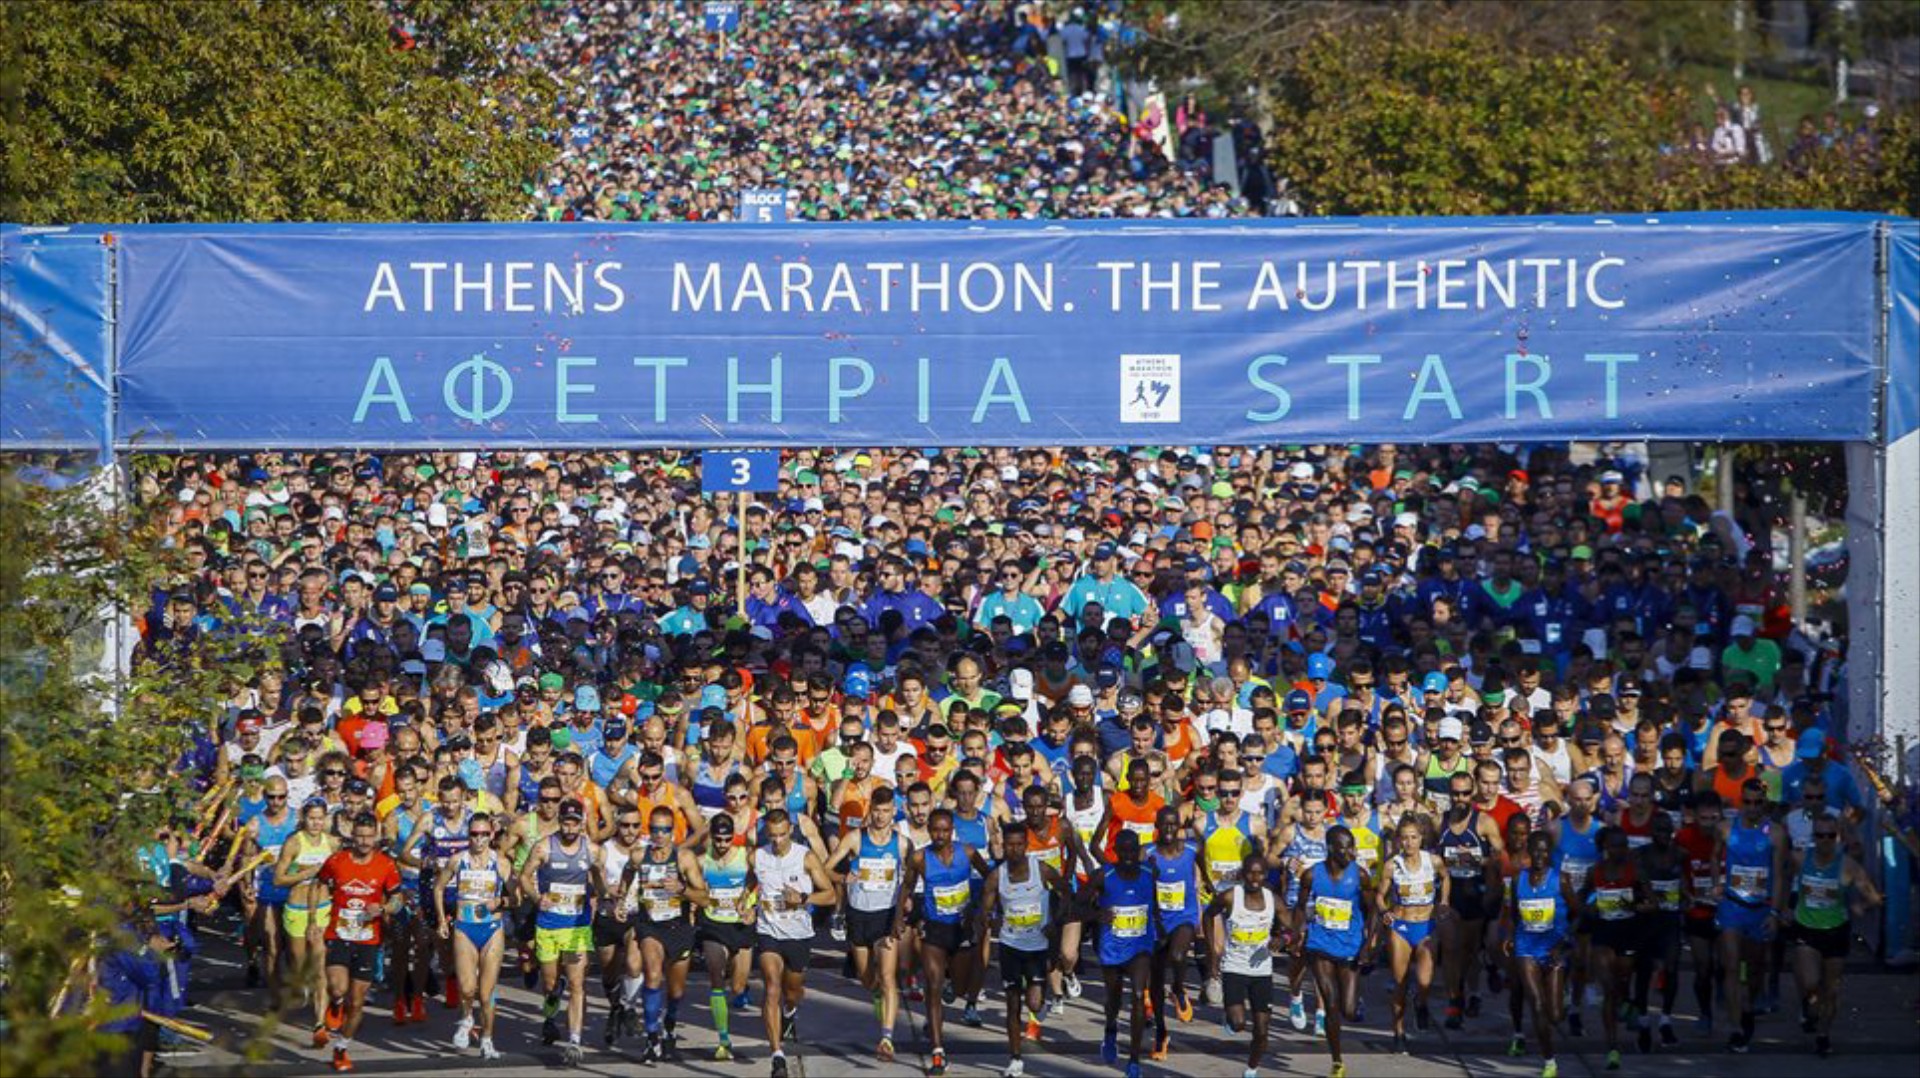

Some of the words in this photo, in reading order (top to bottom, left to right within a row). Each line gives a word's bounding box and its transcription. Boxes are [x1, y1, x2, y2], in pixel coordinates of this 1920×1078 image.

[717, 15, 726, 28] 7
[744, 193, 783, 205] BLOCK
[759, 206, 772, 222] 5
[364, 262, 626, 314] ATHENS
[671, 262, 1076, 313] MARATHON.
[1097, 261, 1222, 312] THE
[1247, 257, 1626, 311] AUTHENTIC
[352, 354, 1033, 425] ΑΦΕΤΗΡΙΑ
[1244, 353, 1640, 422] START
[731, 458, 751, 485] 3
